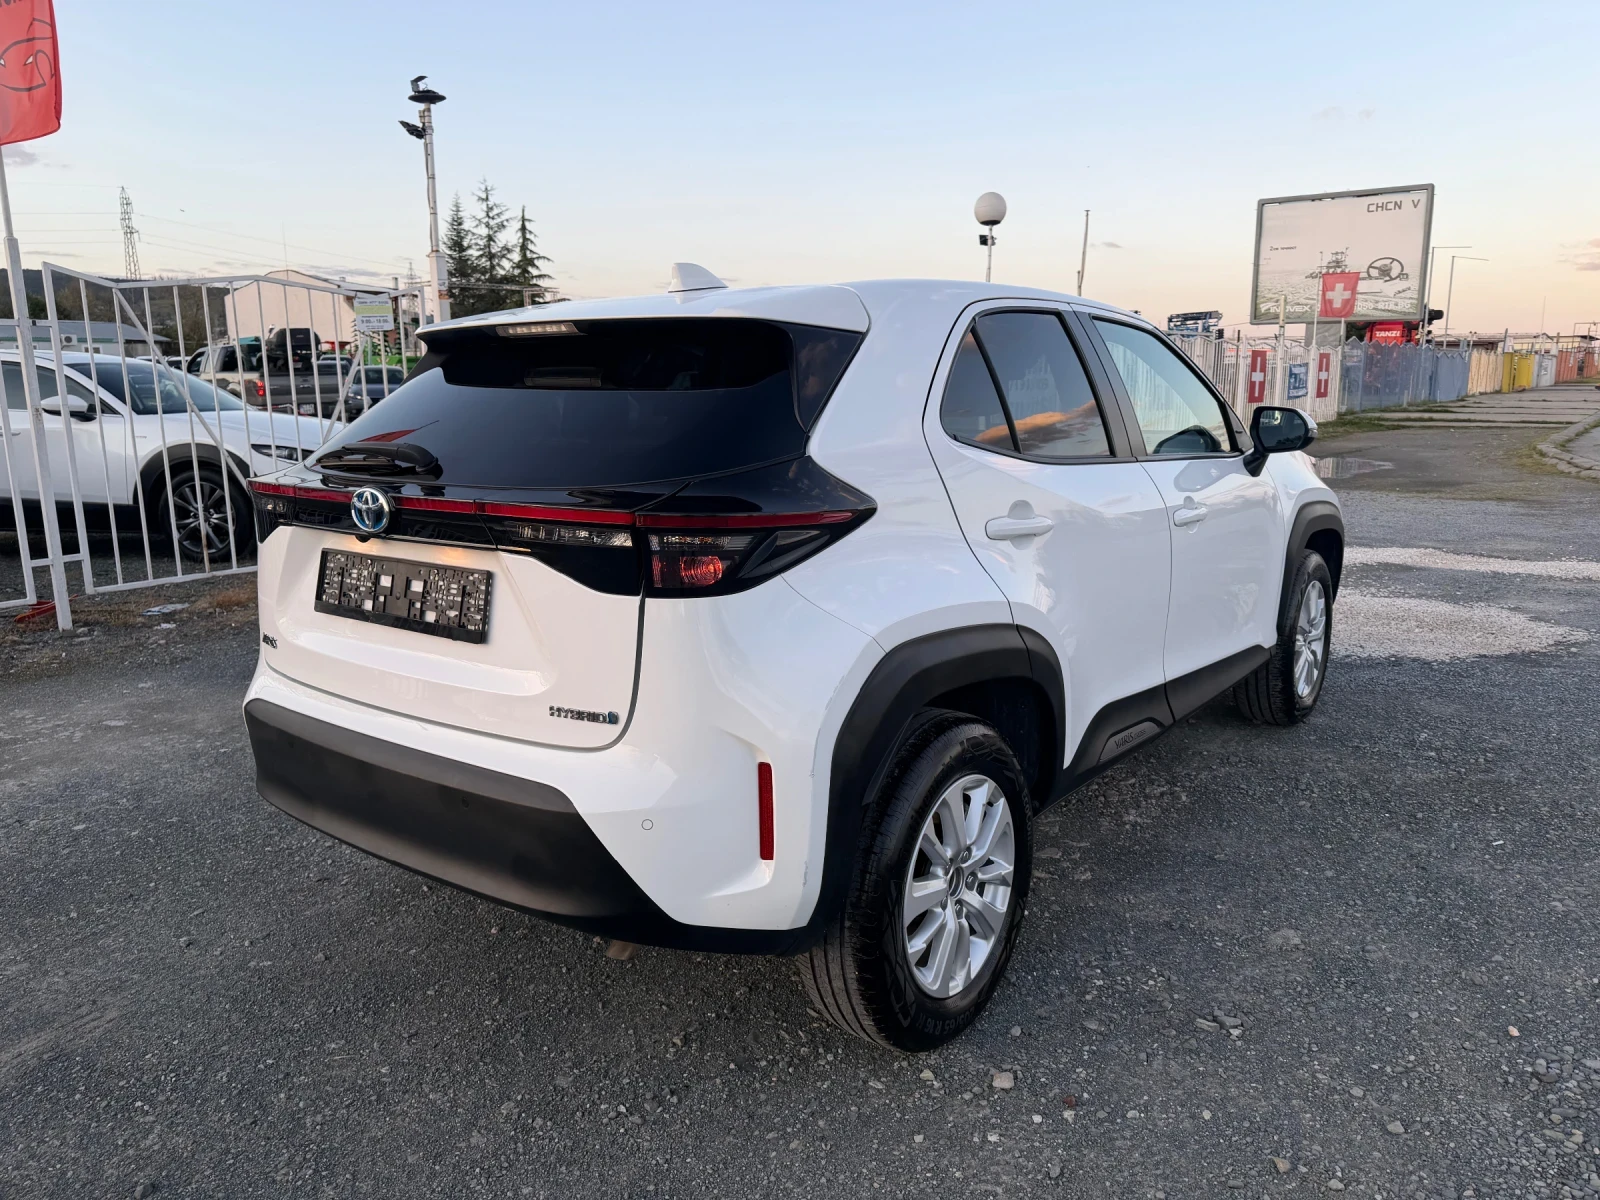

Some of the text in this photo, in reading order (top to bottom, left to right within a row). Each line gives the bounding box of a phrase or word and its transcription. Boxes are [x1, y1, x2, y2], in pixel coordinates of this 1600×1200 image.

[1367, 198, 1420, 212] CHCN V
[548, 705, 608, 724] HYBRID
